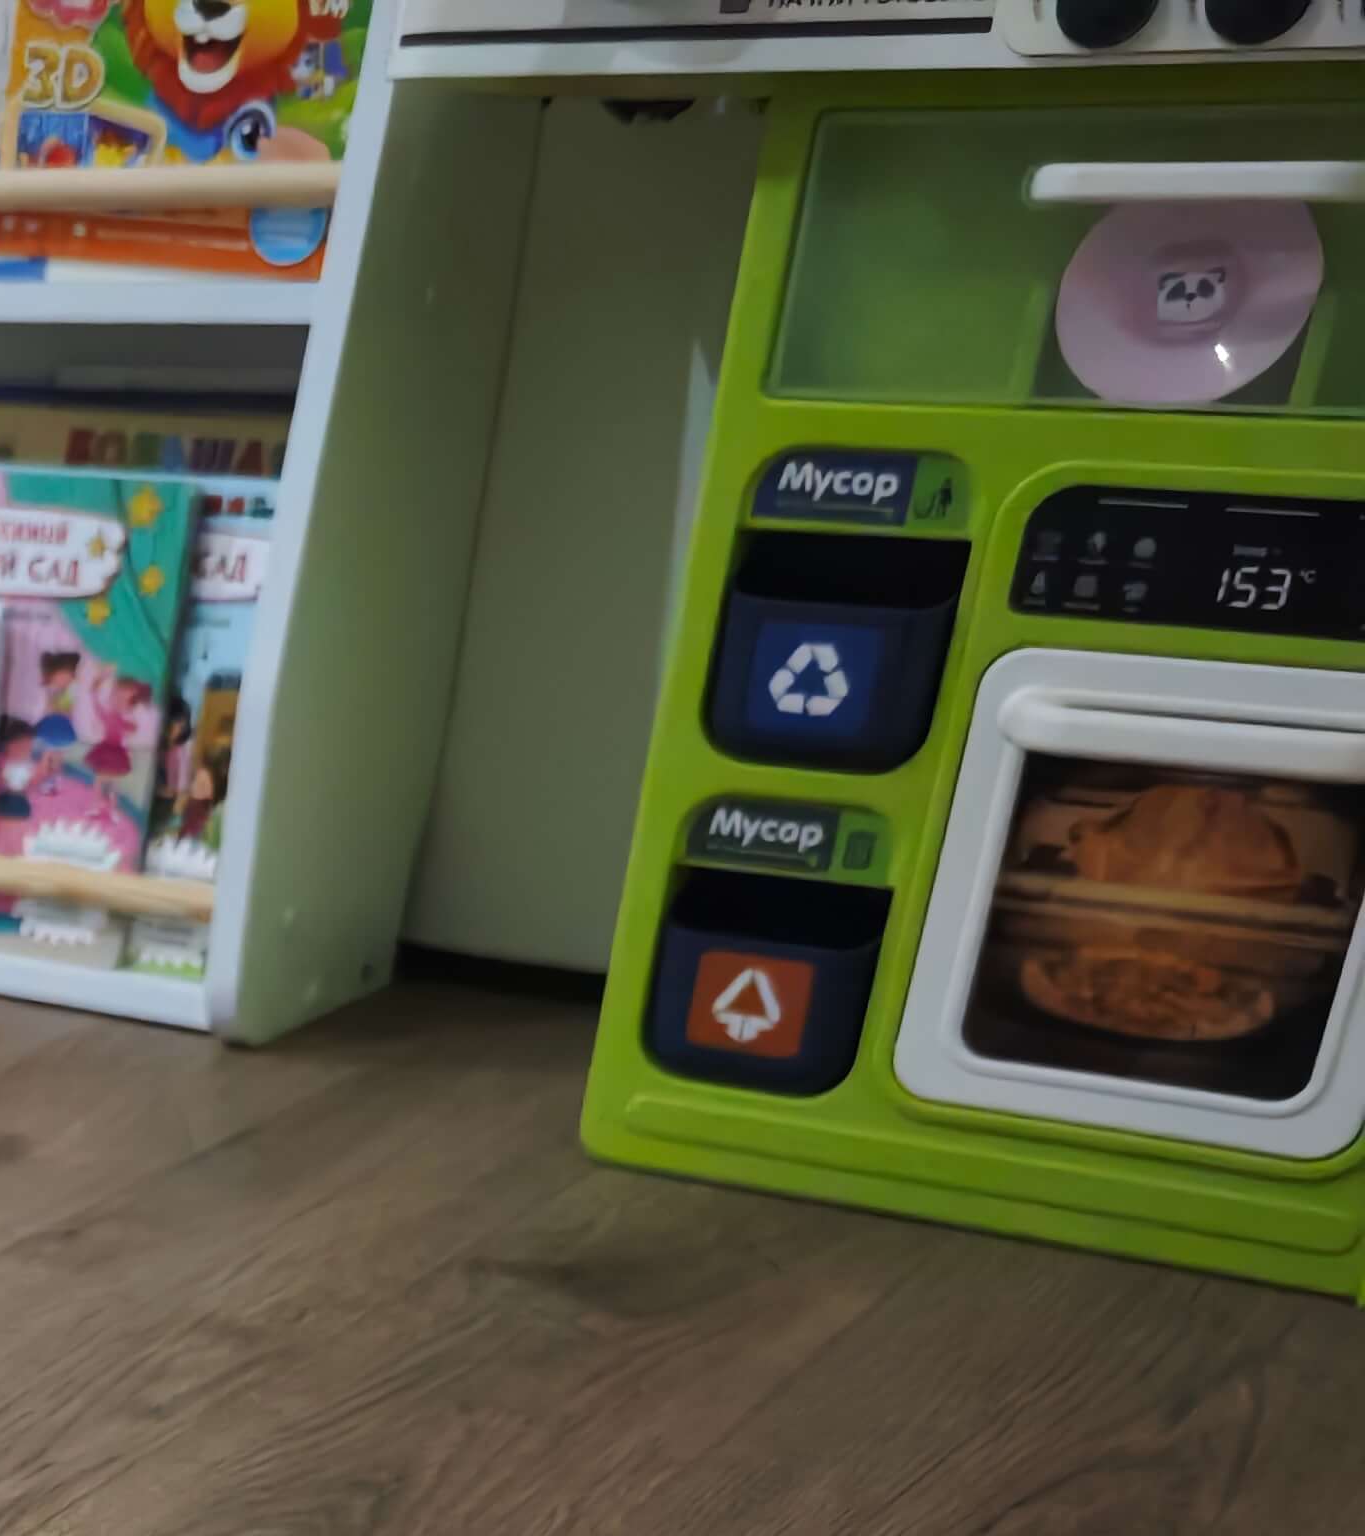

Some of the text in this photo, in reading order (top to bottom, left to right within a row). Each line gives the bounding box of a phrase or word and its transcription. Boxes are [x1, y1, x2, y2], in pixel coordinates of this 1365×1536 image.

[22, 40, 103, 109] 3D
[27, 558, 80, 587] САД
[1217, 566, 1291, 610] 153
